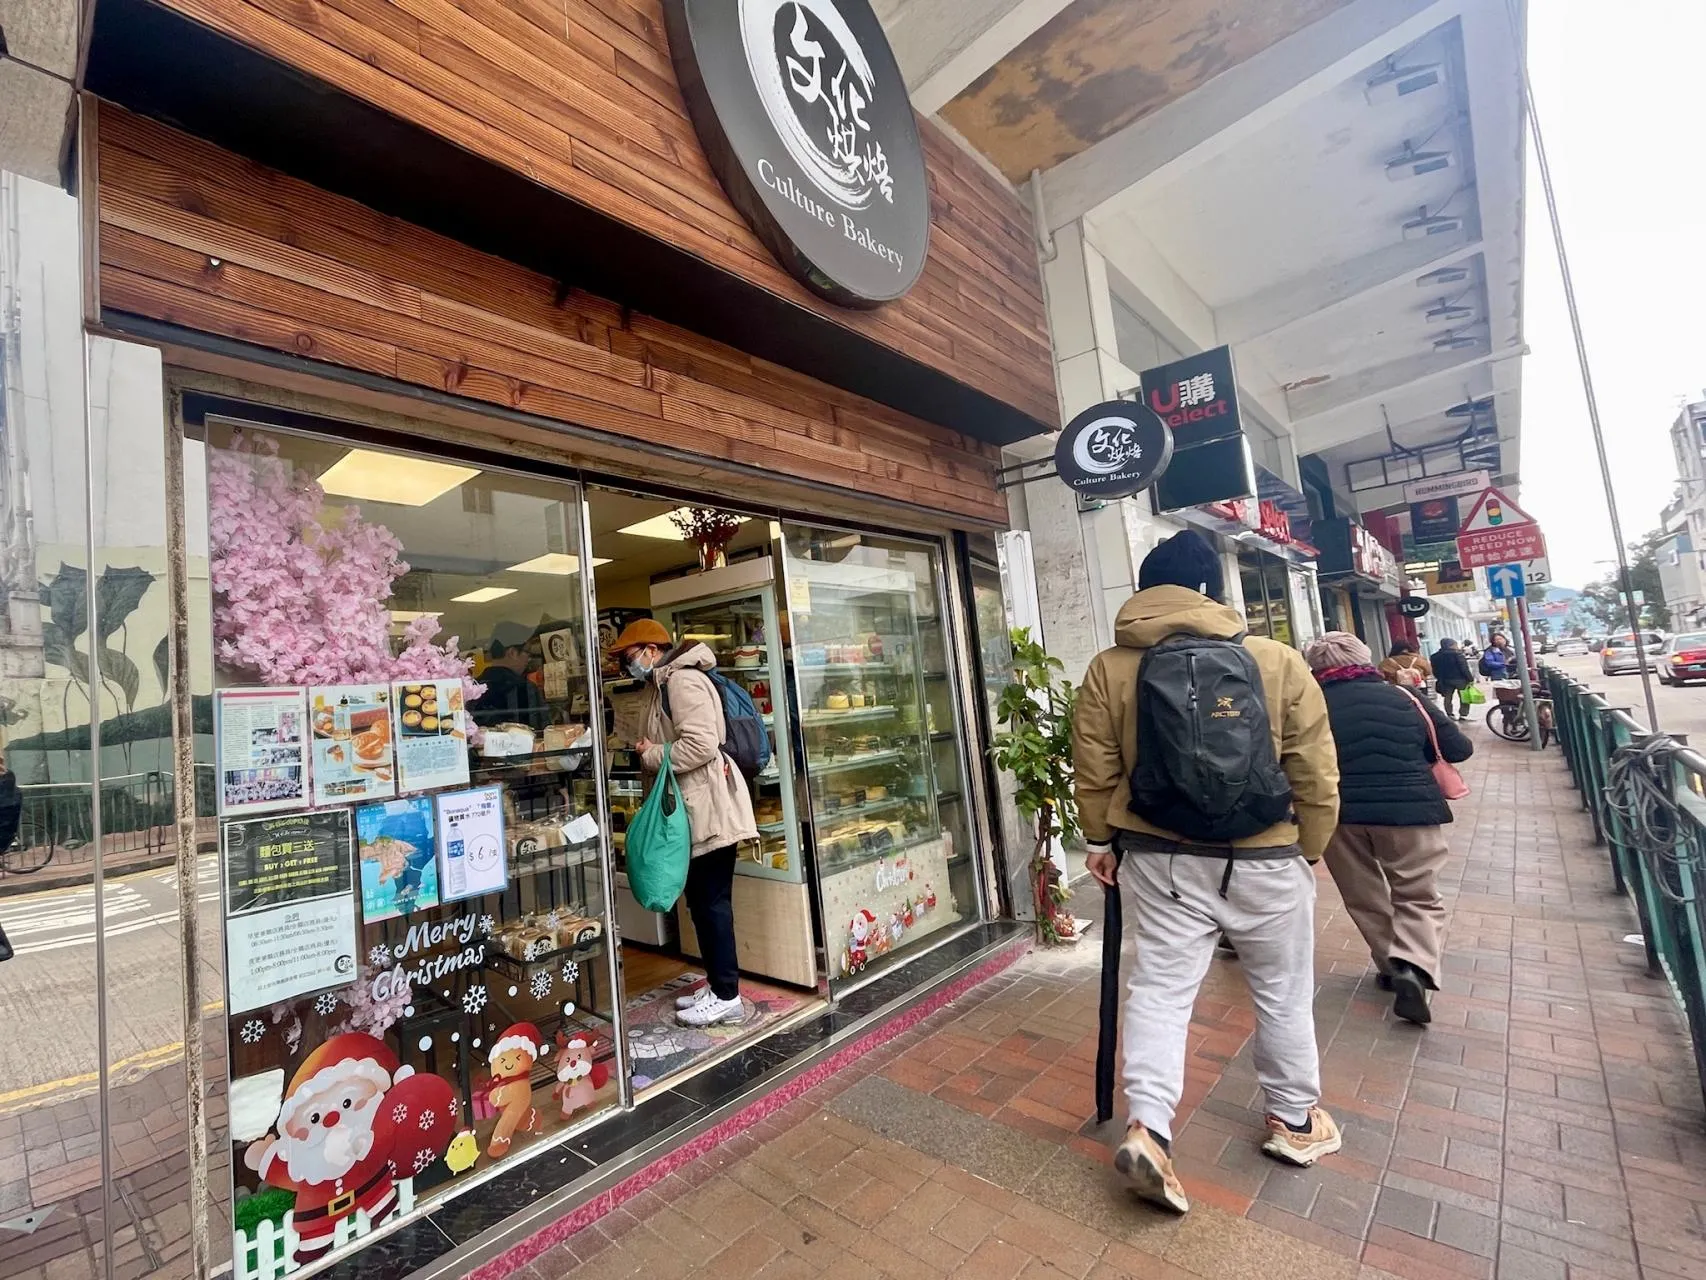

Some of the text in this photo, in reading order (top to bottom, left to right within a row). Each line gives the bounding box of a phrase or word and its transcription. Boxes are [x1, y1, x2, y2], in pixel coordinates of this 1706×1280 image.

[757, 158, 904, 272] Culture Bakery
[1073, 471, 1142, 487] Culture Bakery
[1464, 535, 1537, 553] SPEED NOW
[1473, 530, 1523, 544] REDUCE
[1527, 572, 1546, 582] 12
[477, 845, 484, 860] 6
[264, 861, 281, 871] BUY
[284, 858, 298, 868] GET
[303, 856, 318, 866] FREE
[393, 913, 477, 959] Merry
[372, 944, 485, 1003] Christmas
